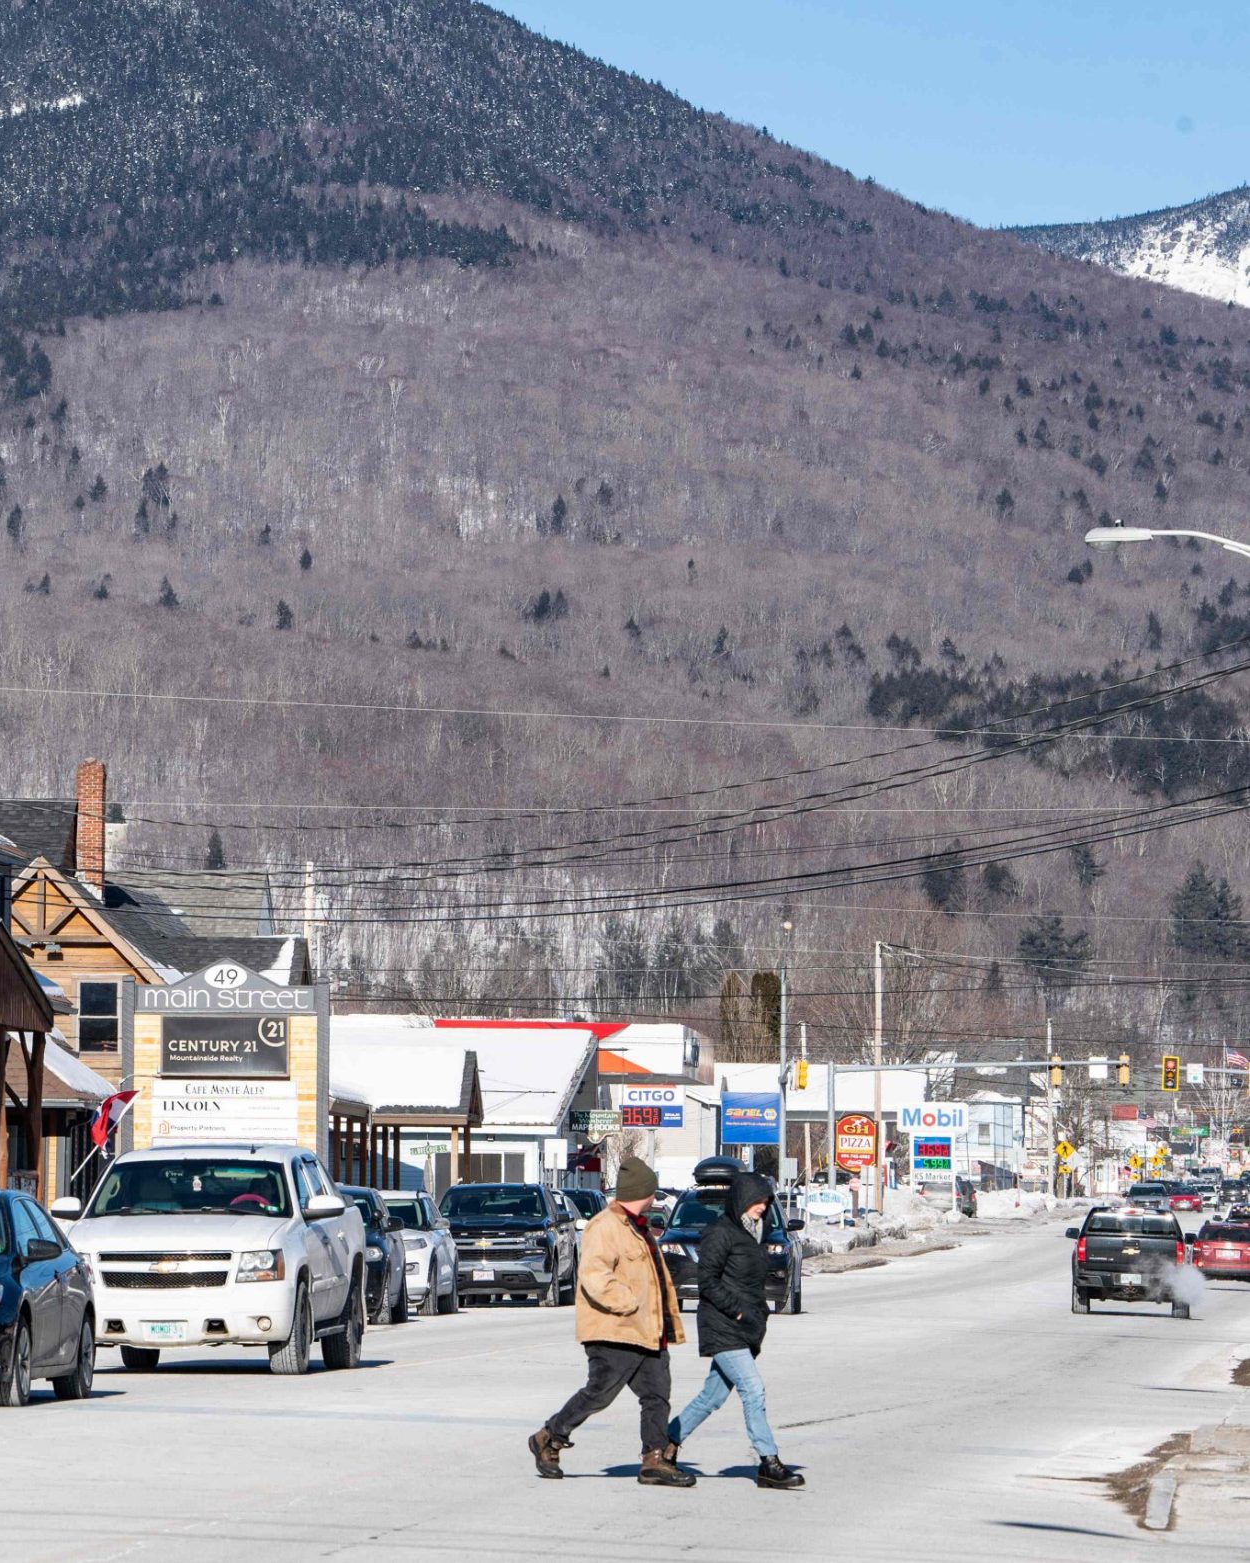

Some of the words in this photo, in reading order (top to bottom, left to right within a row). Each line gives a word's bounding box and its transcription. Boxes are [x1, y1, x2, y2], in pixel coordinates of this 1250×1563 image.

[214, 969, 238, 985] 49
[144, 986, 211, 1008] main
[217, 988, 309, 1009] street
[168, 1040, 240, 1052] CENTURY
[170, 1054, 219, 1062] Mountainside
[220, 1054, 243, 1063] Realty
[628, 1090, 675, 1102] CITGO
[163, 1100, 221, 1112] LINCOLN
[902, 1108, 963, 1128] Mobil
[841, 1137, 871, 1148] PIZZA
[926, 1173, 951, 1181] Market
